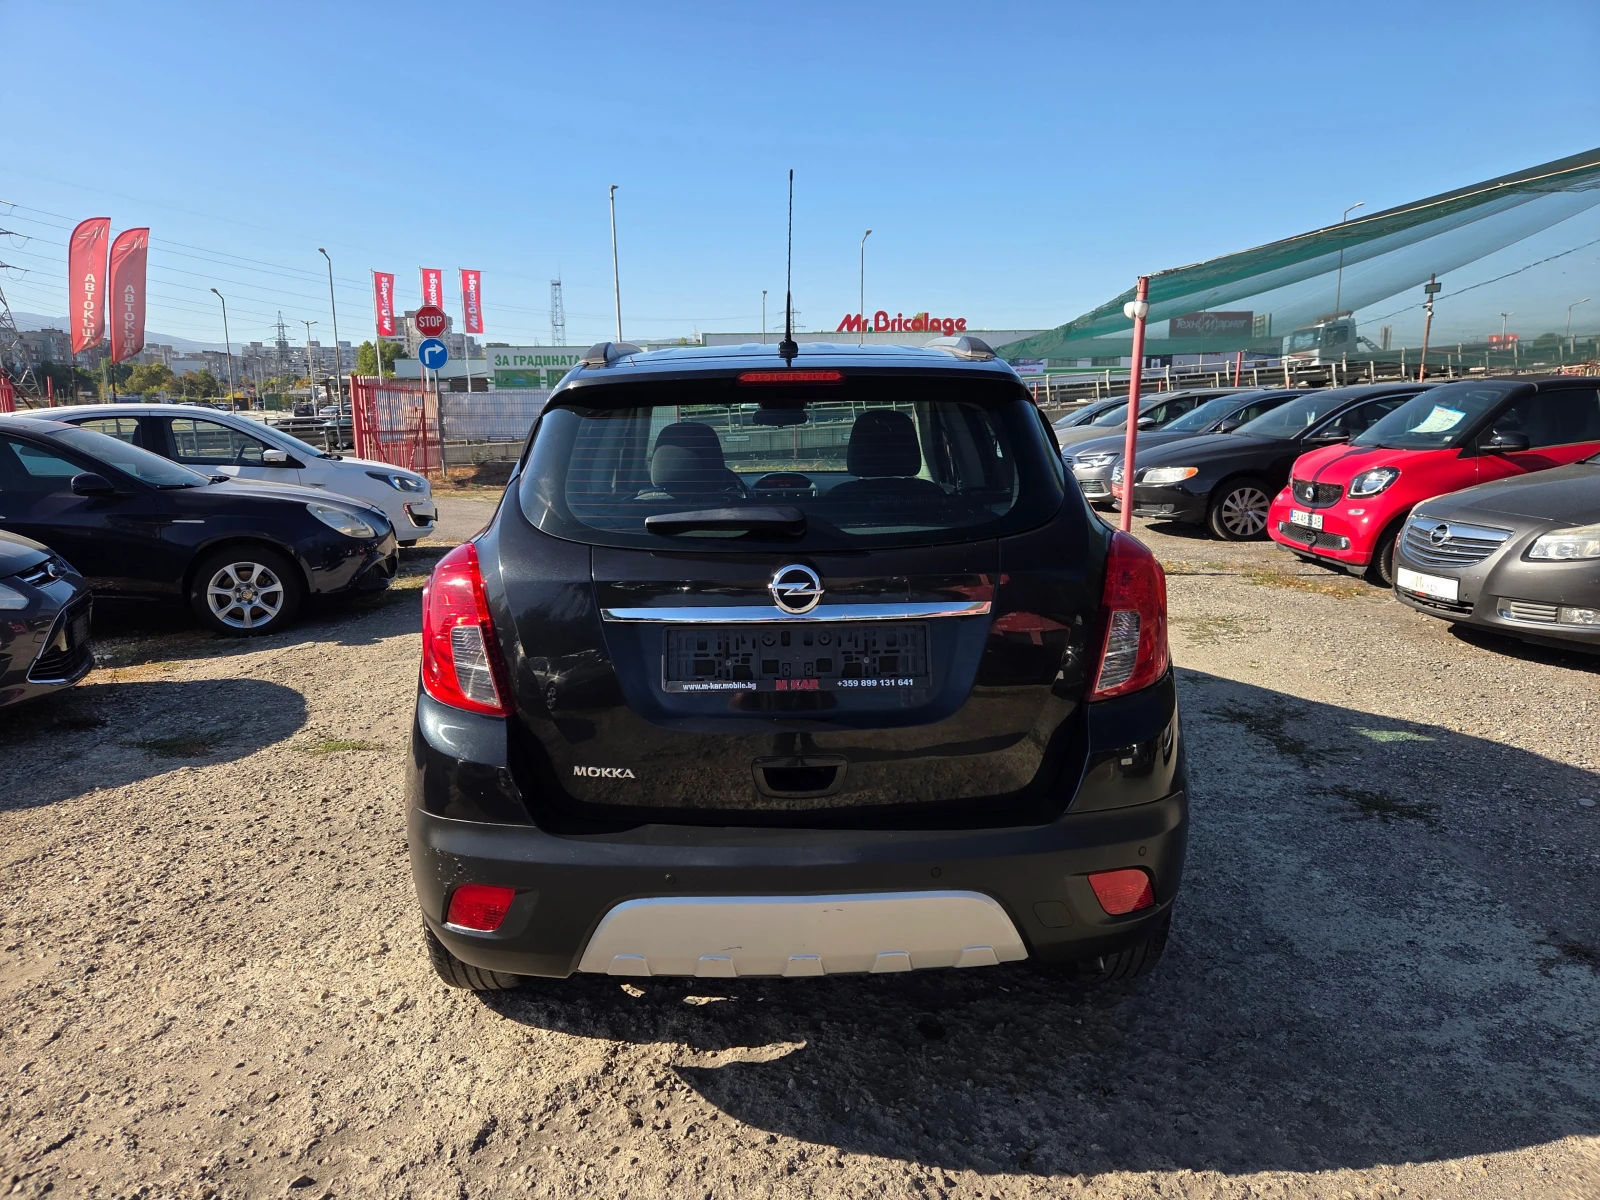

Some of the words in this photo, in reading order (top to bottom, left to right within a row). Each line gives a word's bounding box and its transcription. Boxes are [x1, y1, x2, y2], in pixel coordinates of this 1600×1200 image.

[418, 315, 443, 328] STOP
[494, 354, 510, 367] ЗА
[513, 354, 581, 368] ГРАДИНАТА
[682, 681, 757, 691] www.m-kar.mobile.bg
[775, 679, 788, 691] M
[790, 678, 820, 691] KAR
[837, 679, 859, 687] +359
[860, 679, 878, 687] 899
[880, 678, 895, 687] 131
[897, 678, 914, 686] 641
[573, 765, 637, 779] MOKKA
